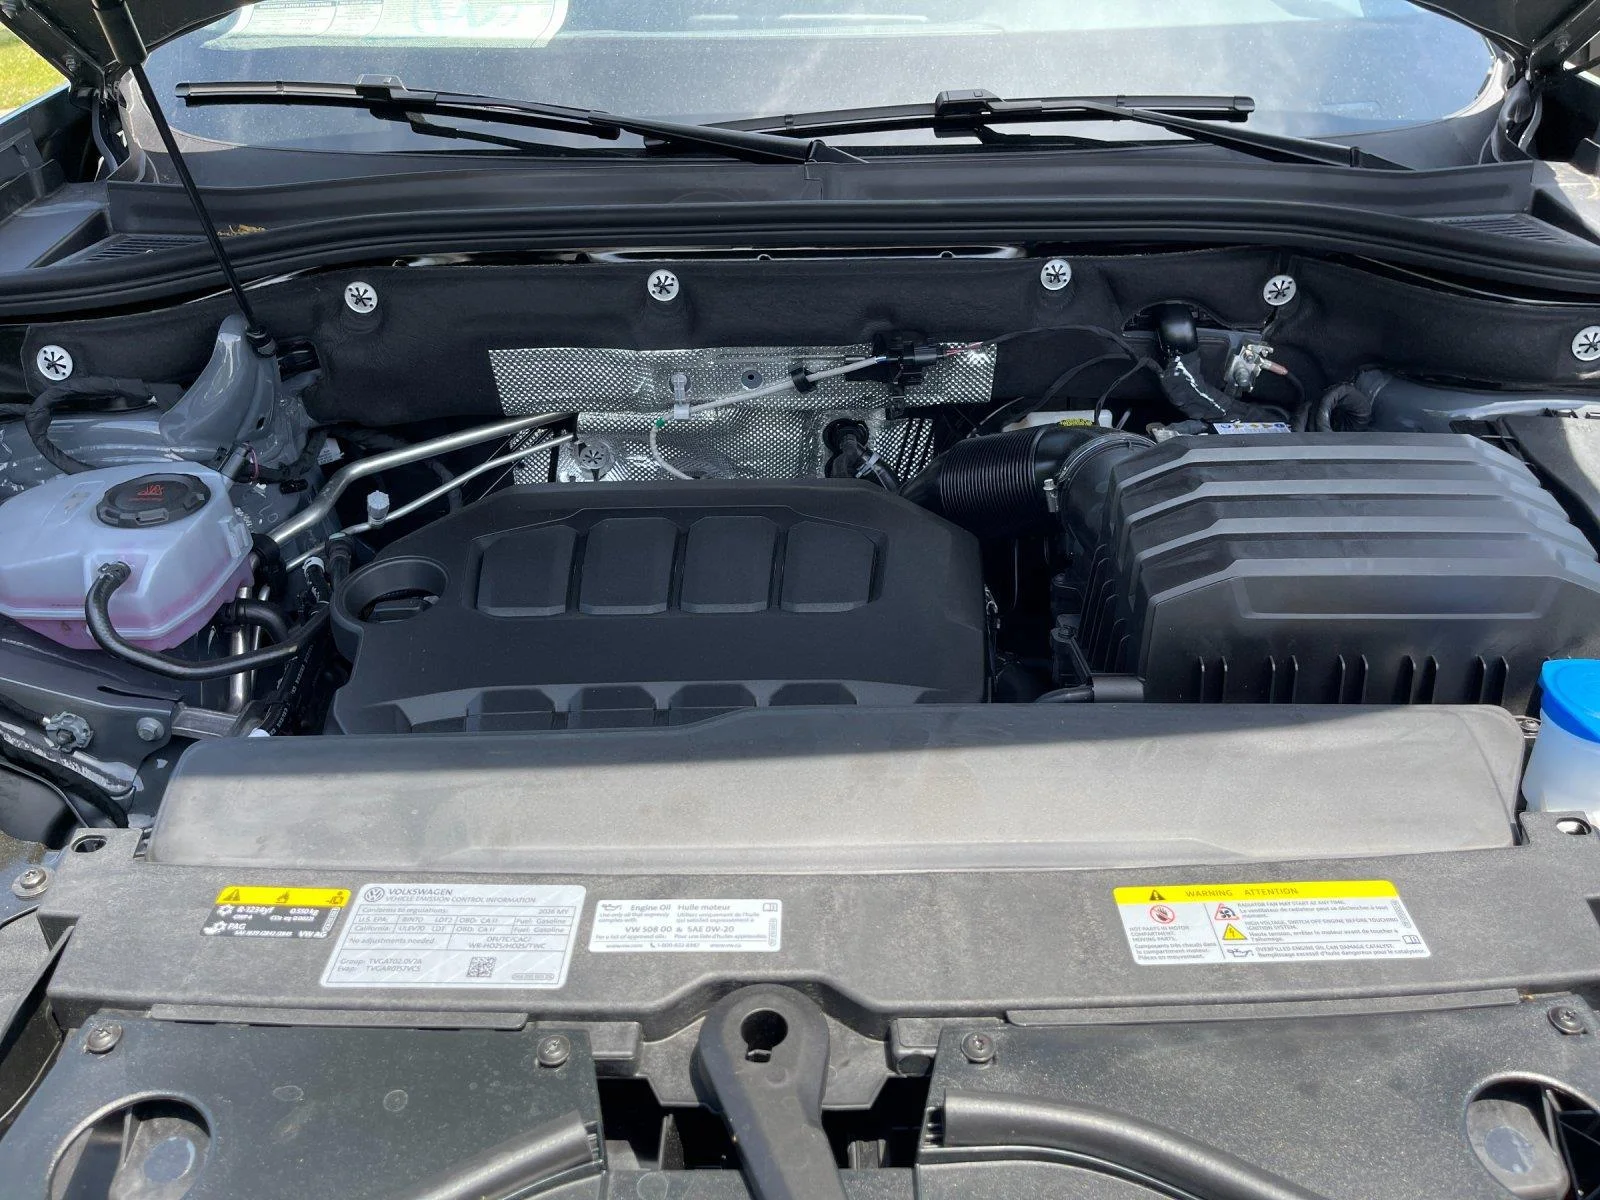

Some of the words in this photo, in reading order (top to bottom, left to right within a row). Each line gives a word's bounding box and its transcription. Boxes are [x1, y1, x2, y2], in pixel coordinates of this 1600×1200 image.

[1185, 889, 1233, 897] WARNING
[1245, 888, 1299, 896] ATTENTION
[630, 904, 659, 912] Engine
[660, 925, 673, 933] 00
[361, 937, 406, 945] adjustments
